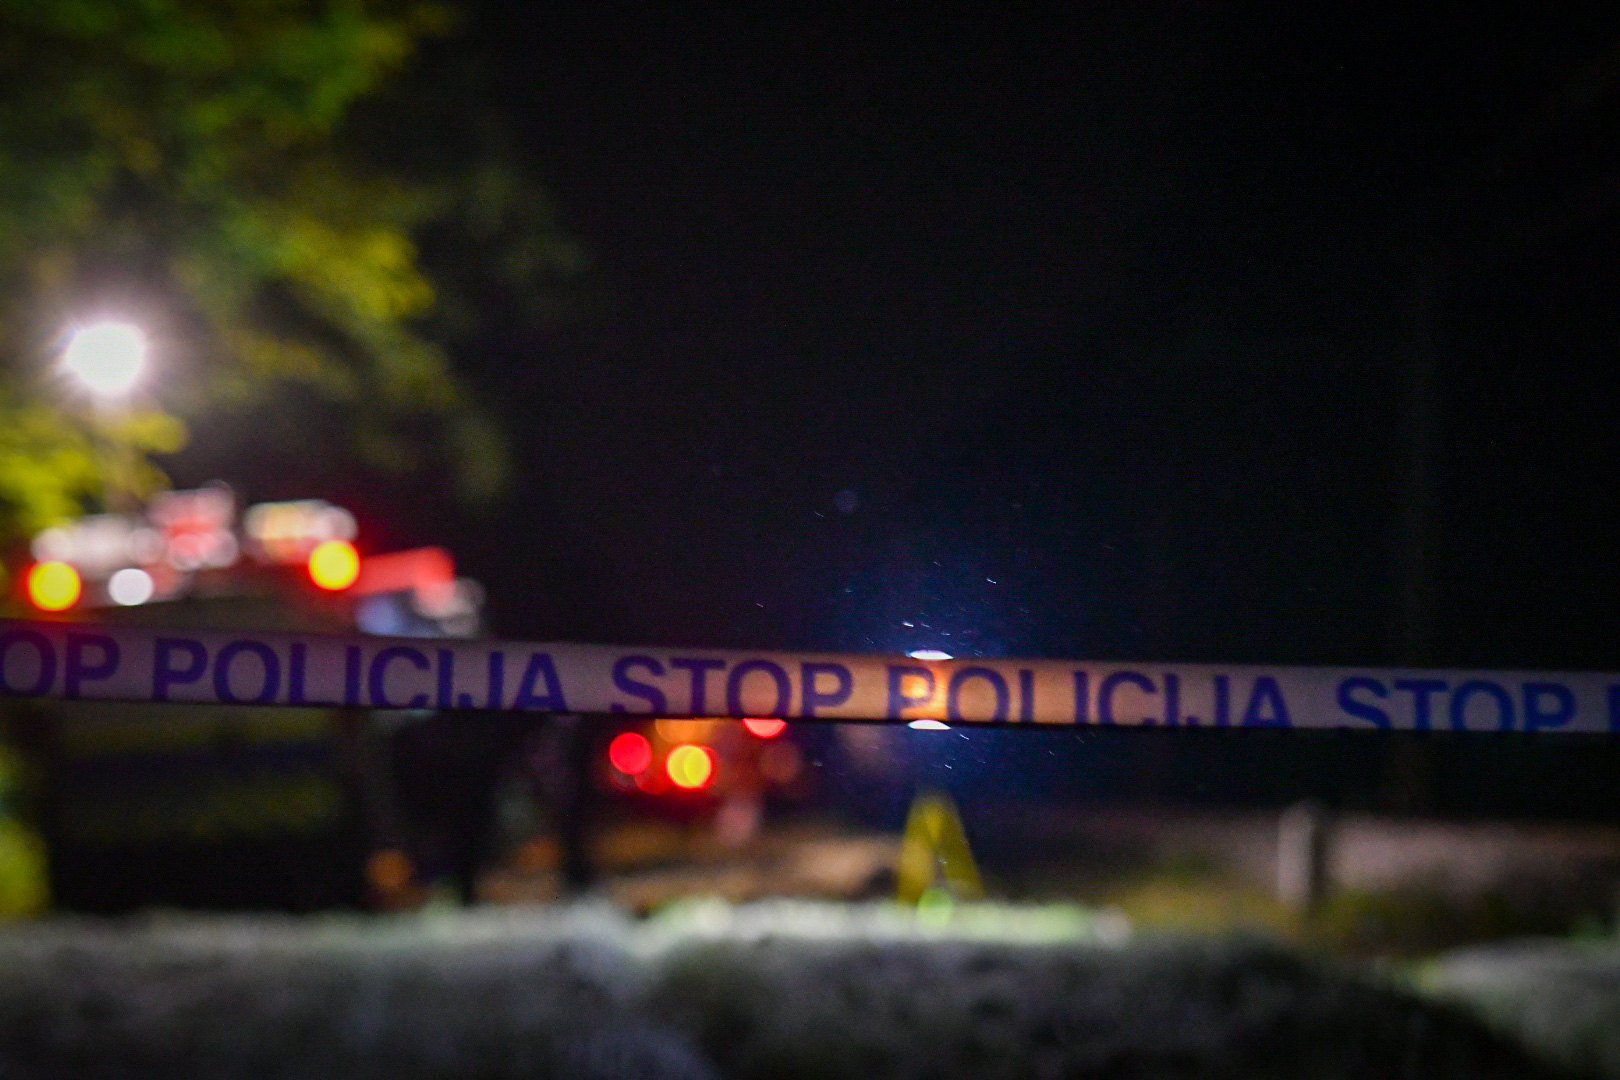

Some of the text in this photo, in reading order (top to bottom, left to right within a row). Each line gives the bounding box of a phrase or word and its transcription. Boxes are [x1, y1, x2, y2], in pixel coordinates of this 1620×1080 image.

[152, 636, 571, 712] POLICIJA
[610, 655, 854, 717] STOP
[887, 665, 1293, 728] POLICIJA
[1336, 676, 1577, 731] STOP
